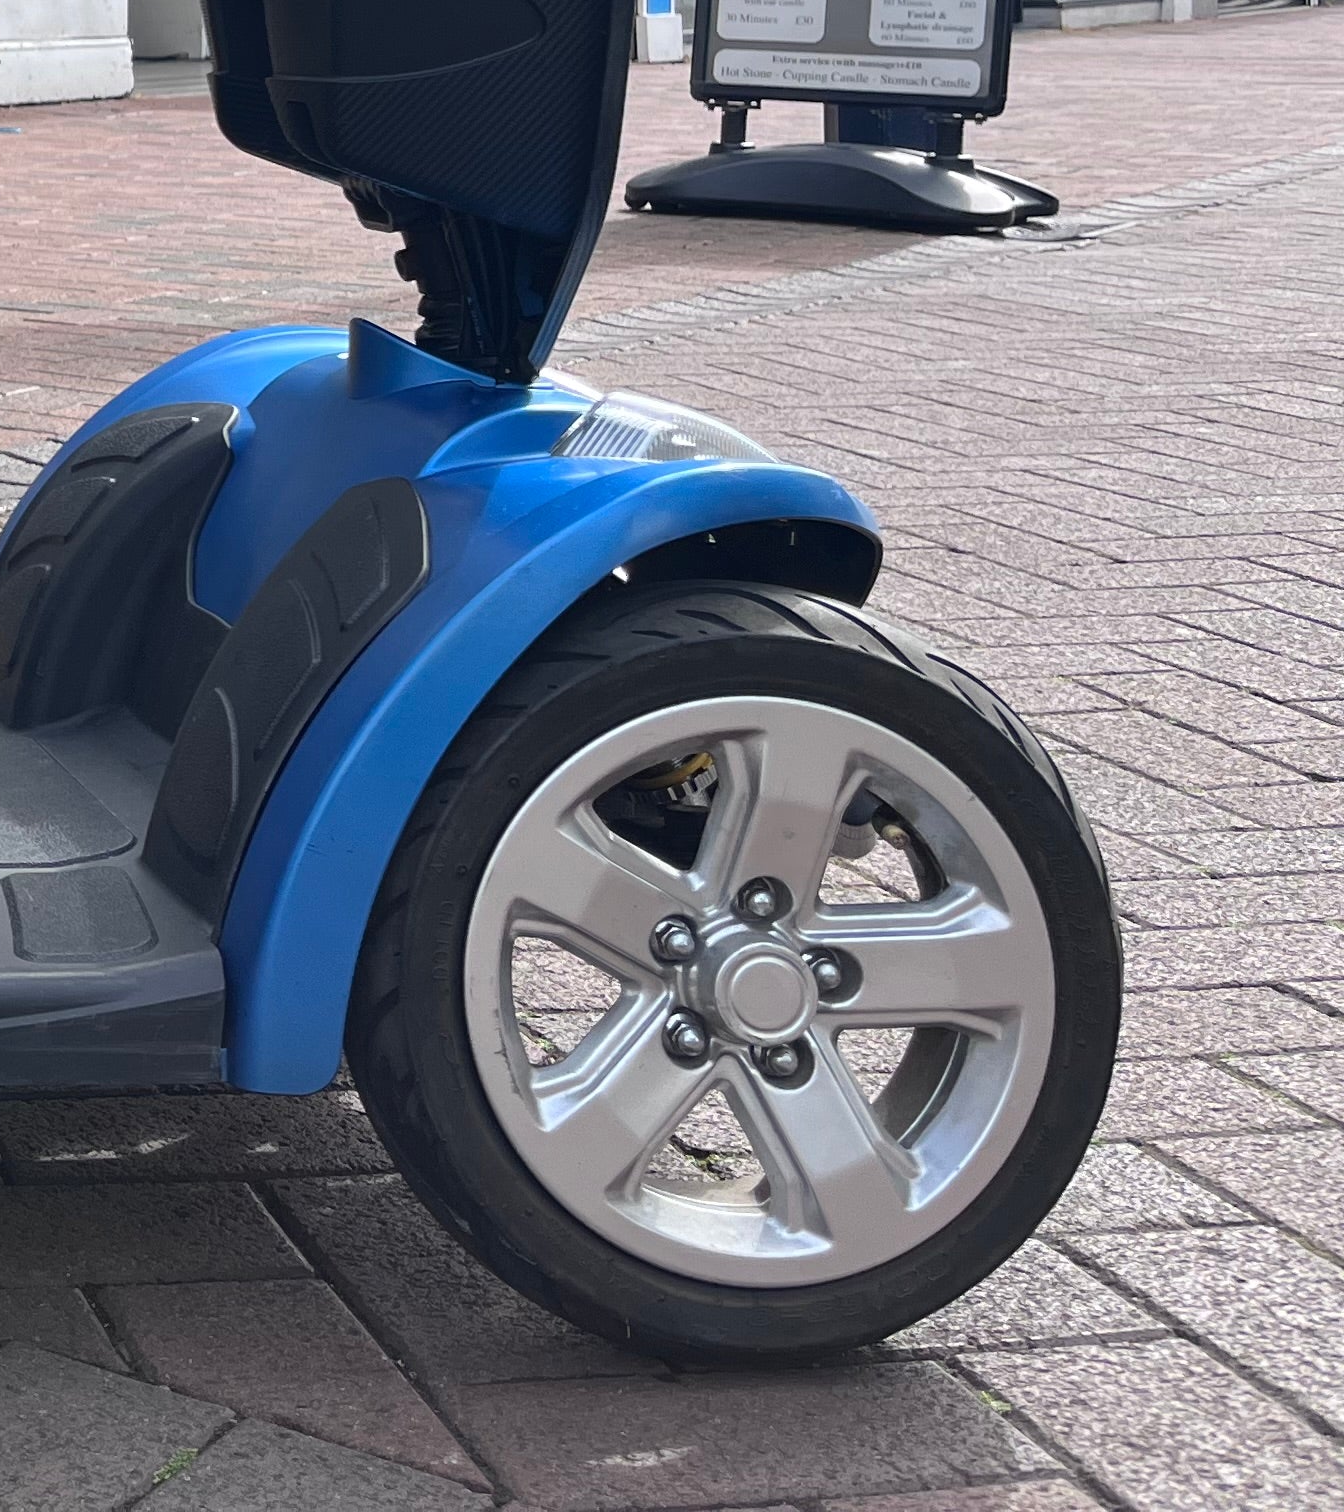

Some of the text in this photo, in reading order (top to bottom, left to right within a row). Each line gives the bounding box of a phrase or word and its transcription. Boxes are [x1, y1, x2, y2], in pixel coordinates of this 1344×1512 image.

[740, 13, 778, 24] Minutes
[720, 65, 740, 77] Hot
[743, 66, 773, 78] Stone
[782, 68, 828, 83] Cupping
[831, 70, 870, 83] Candle
[880, 73, 928, 87] Stomach
[931, 76, 972, 89] Candle
